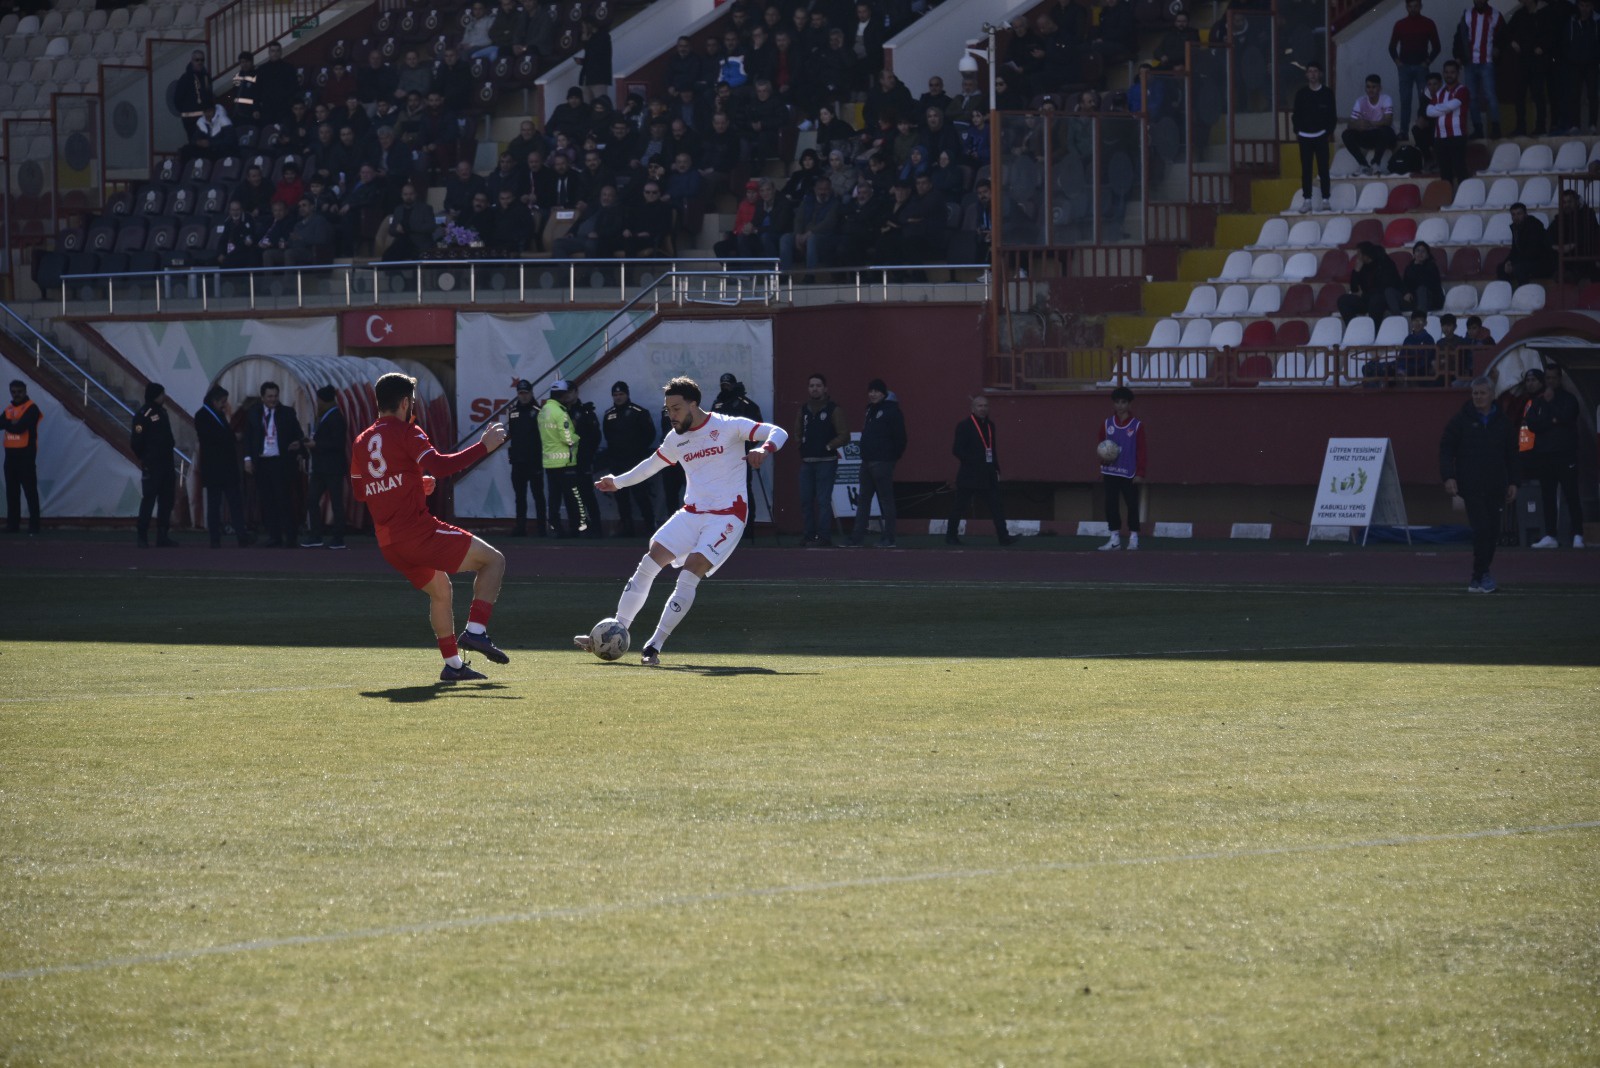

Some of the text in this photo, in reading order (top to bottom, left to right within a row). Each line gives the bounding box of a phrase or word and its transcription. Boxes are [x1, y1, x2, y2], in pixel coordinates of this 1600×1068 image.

[368, 433, 387, 478] 3
[365, 473, 403, 497] ATALAY
[714, 532, 727, 548] 7
